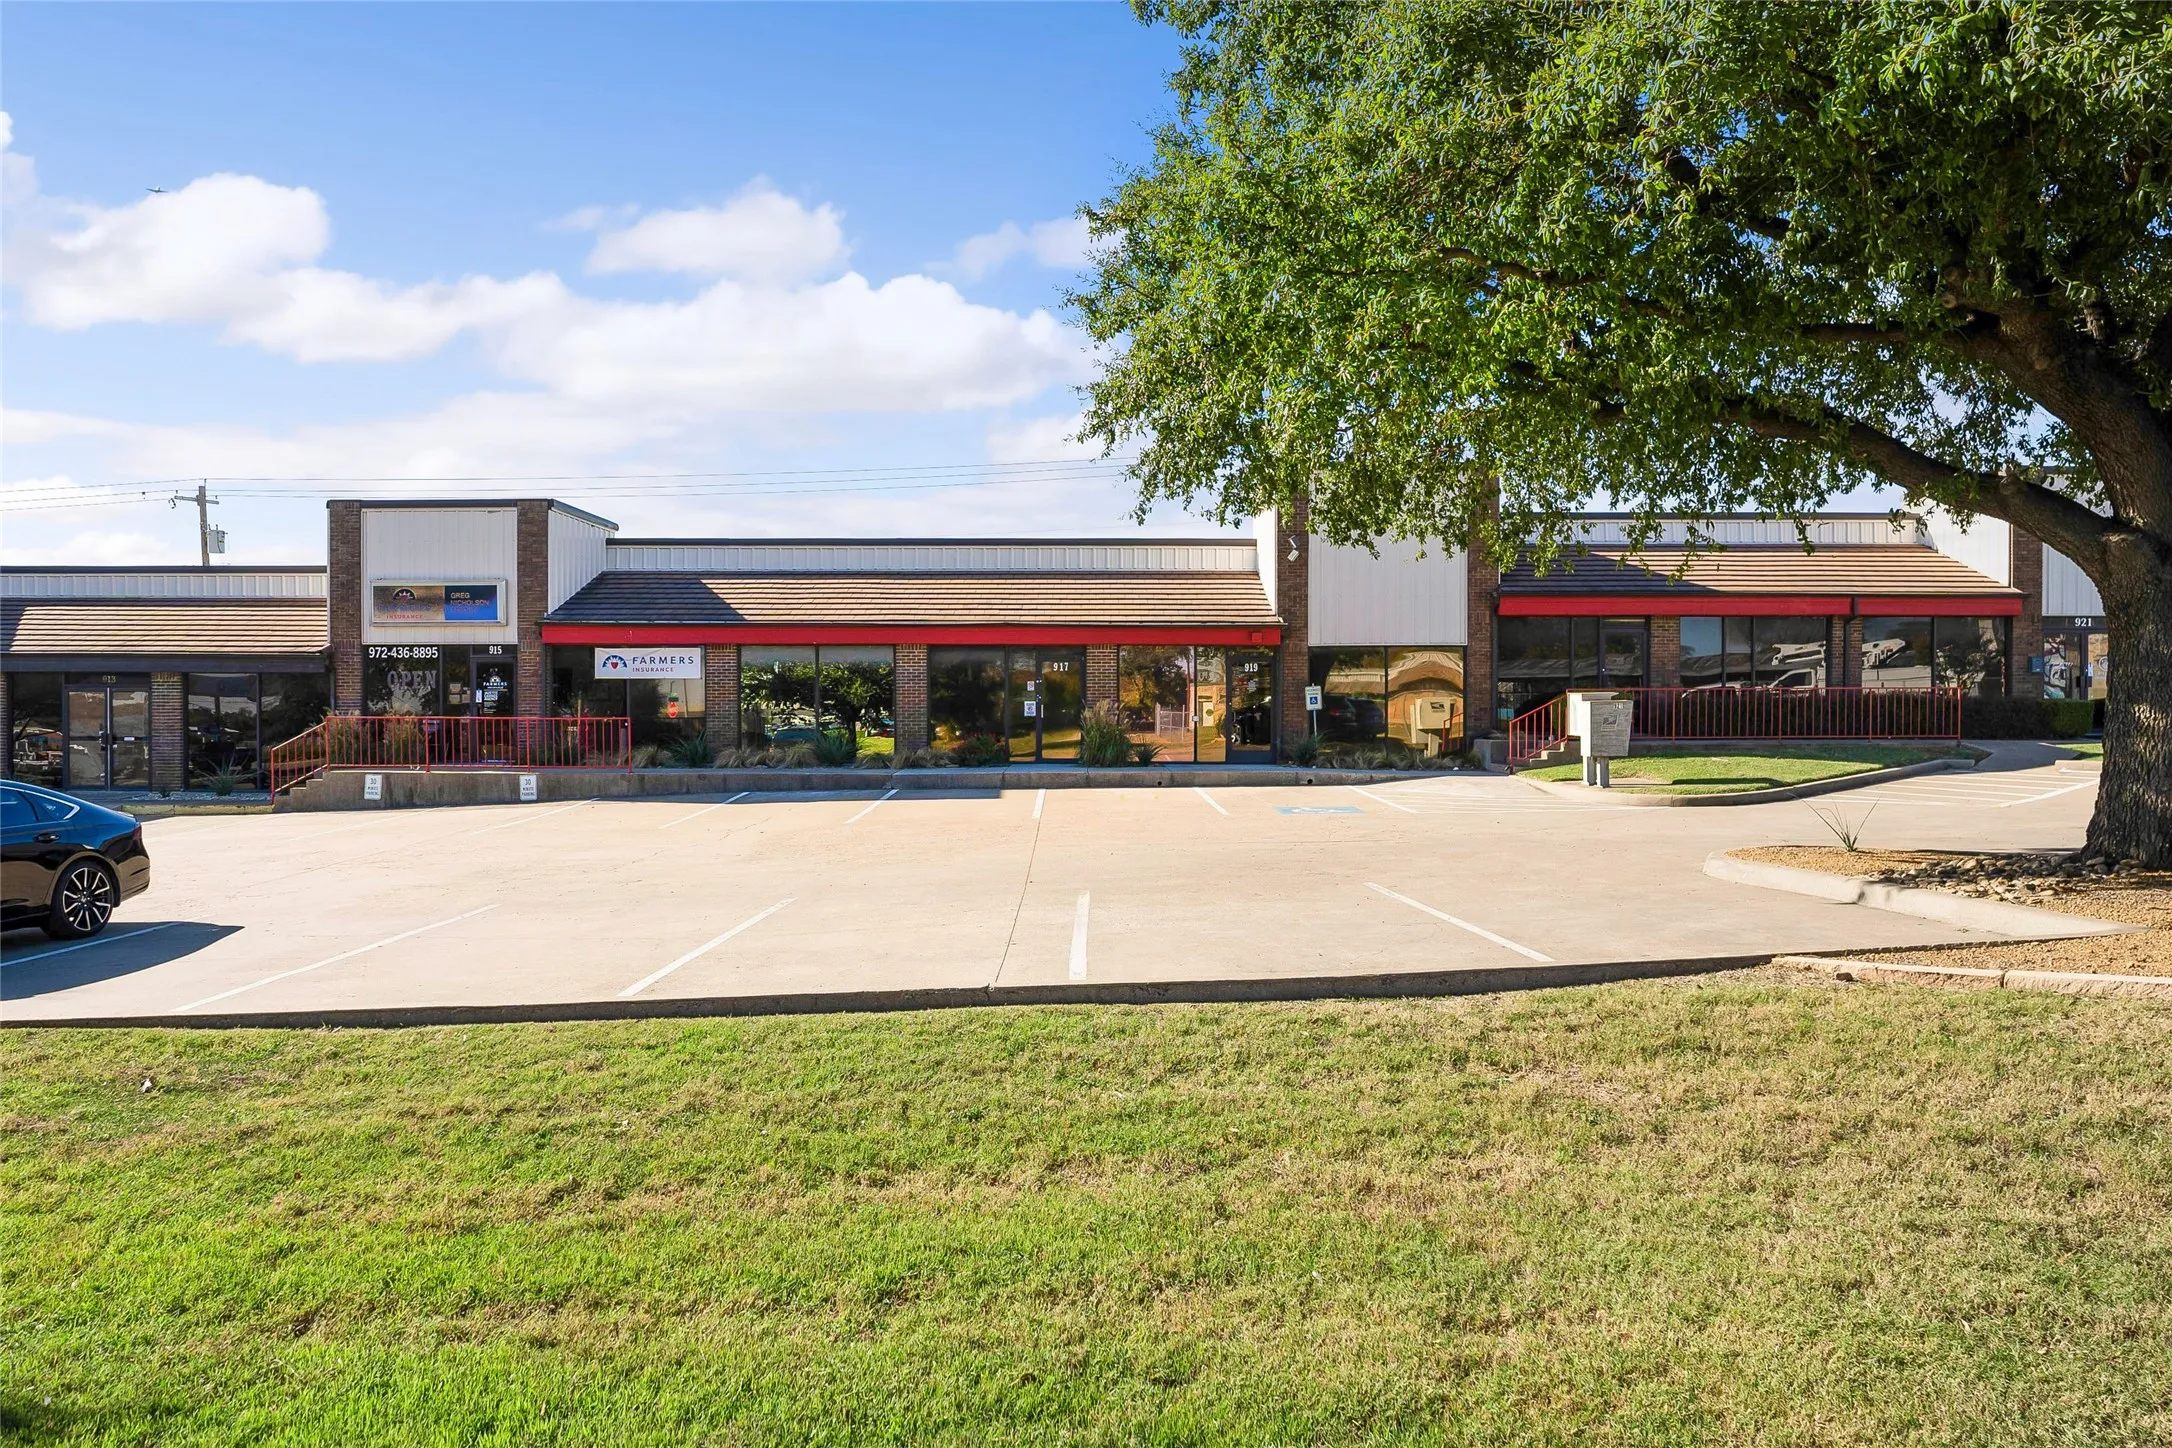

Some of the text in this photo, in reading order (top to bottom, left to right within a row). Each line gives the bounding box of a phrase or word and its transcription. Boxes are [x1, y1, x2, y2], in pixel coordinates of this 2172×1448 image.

[2074, 617, 2092, 627] 921
[368, 647, 438, 658] 972-436-8895
[488, 645, 502, 655] 915
[632, 656, 694, 665] FARMERS
[1053, 662, 1069, 672] 917
[1244, 663, 1258, 672] 919
[387, 670, 436, 689] OPEN
